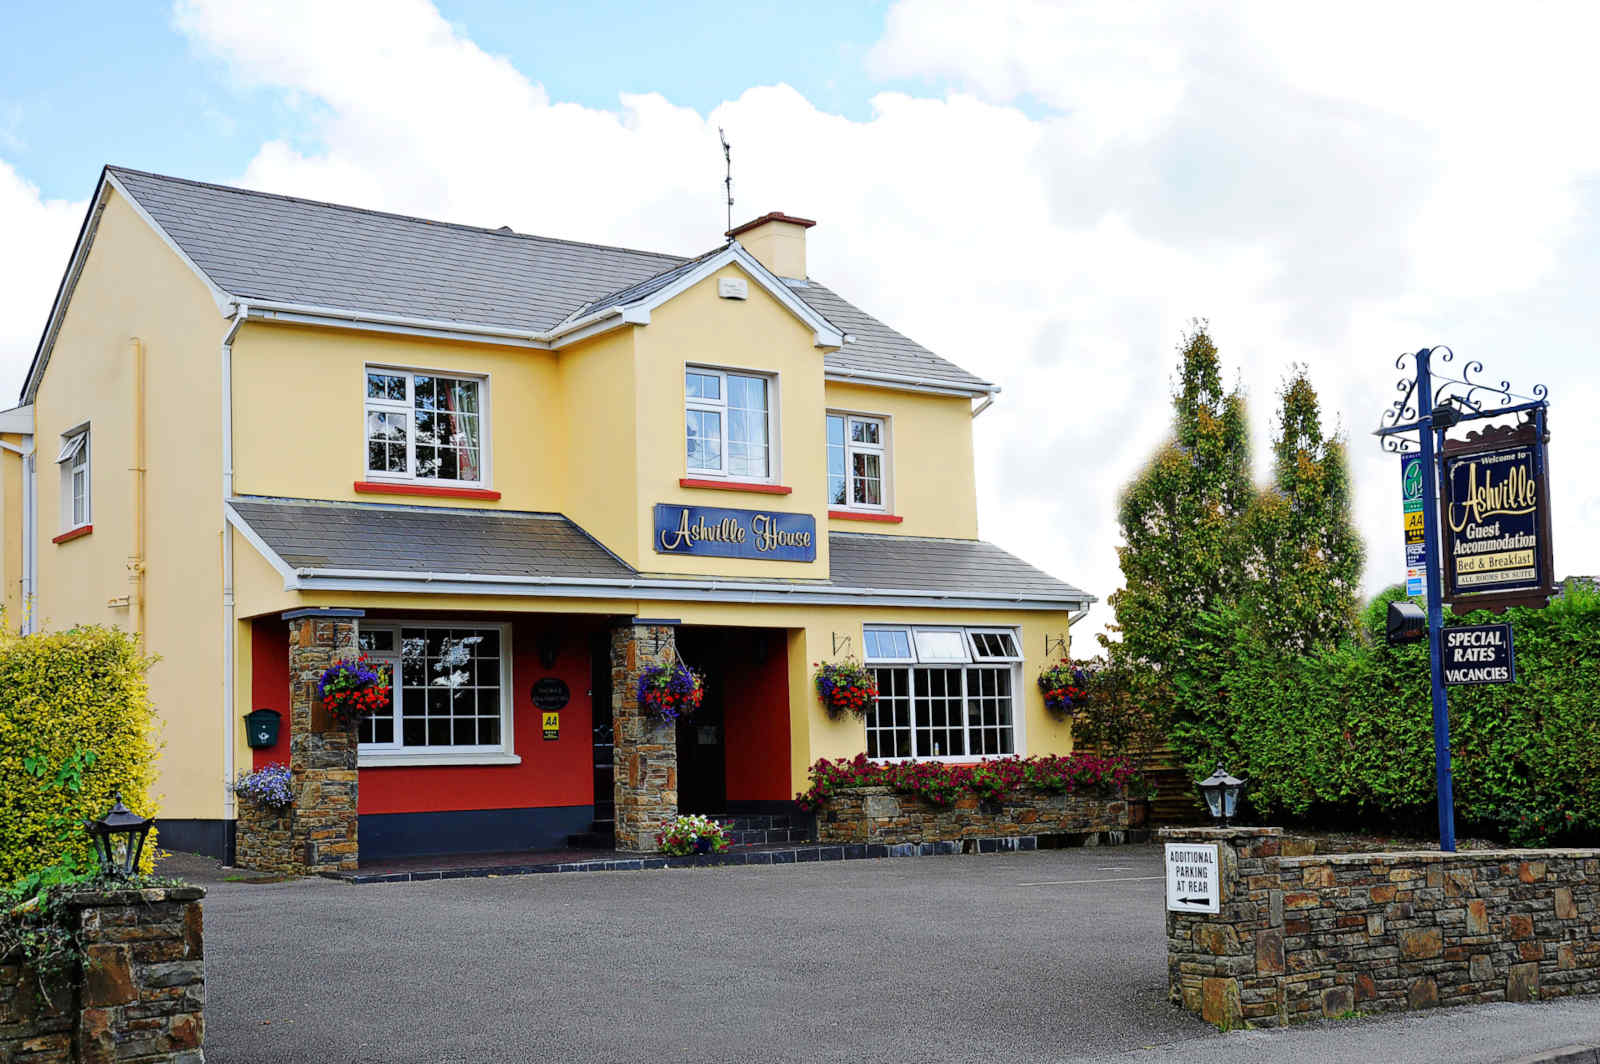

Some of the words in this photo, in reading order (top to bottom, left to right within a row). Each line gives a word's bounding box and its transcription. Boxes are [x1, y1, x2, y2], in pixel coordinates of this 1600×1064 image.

[1481, 454, 1516, 465] Welcome
[1448, 462, 1536, 532] Ashville
[661, 509, 746, 550] Ashville
[752, 514, 812, 552] House
[1466, 521, 1501, 540] Guest
[1453, 531, 1537, 555] Accommodation
[1458, 558, 1475, 571] Bed
[1478, 557, 1486, 569] &
[1489, 553, 1531, 568] Breakfast
[1447, 631, 1503, 647] SPECIAL
[1454, 647, 1496, 662] RATES
[1446, 667, 1508, 682] VACANCIES
[545, 715, 558, 727] AA
[1170, 851, 1214, 864] ADDITIONAL
[1175, 866, 1209, 879] PARKING
[1176, 880, 1185, 892] AT
[1188, 881, 1209, 893] REAR
